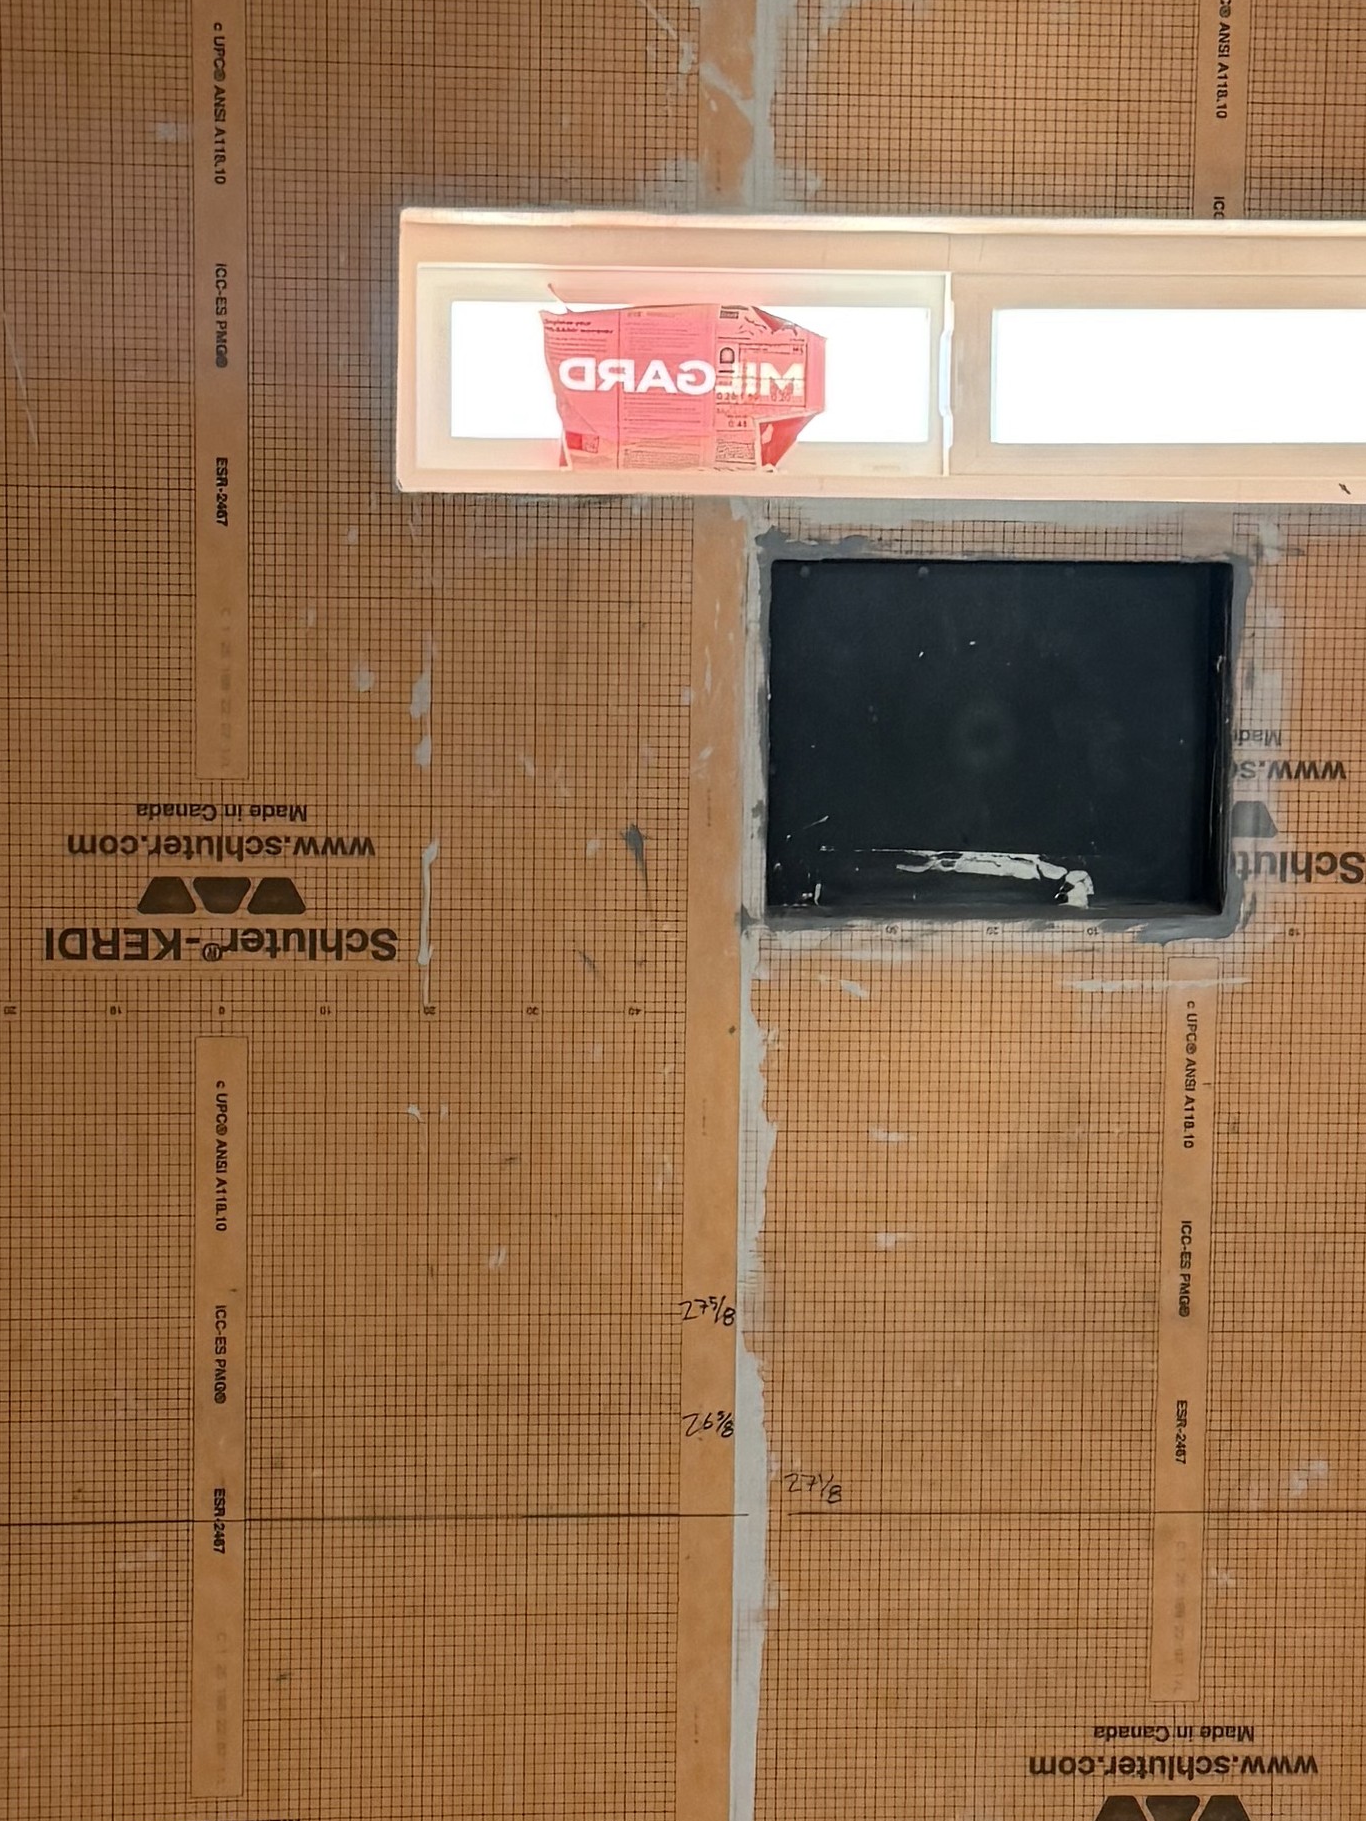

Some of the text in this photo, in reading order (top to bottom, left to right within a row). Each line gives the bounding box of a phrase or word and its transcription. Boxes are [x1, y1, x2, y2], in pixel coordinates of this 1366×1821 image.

[1218, 22, 1231, 58] ANSI
[1216, 62, 1229, 119] A118.10
[136, 803, 307, 822] Made in Canada
[67, 834, 376, 863] www.schluter.com
[1184, 1058, 1196, 1092] ANSI
[215, 1140, 228, 1174] ANSI
[1094, 1725, 1254, 1742] Made in Canada
[1029, 1755, 1317, 1781] www.schluter.com
